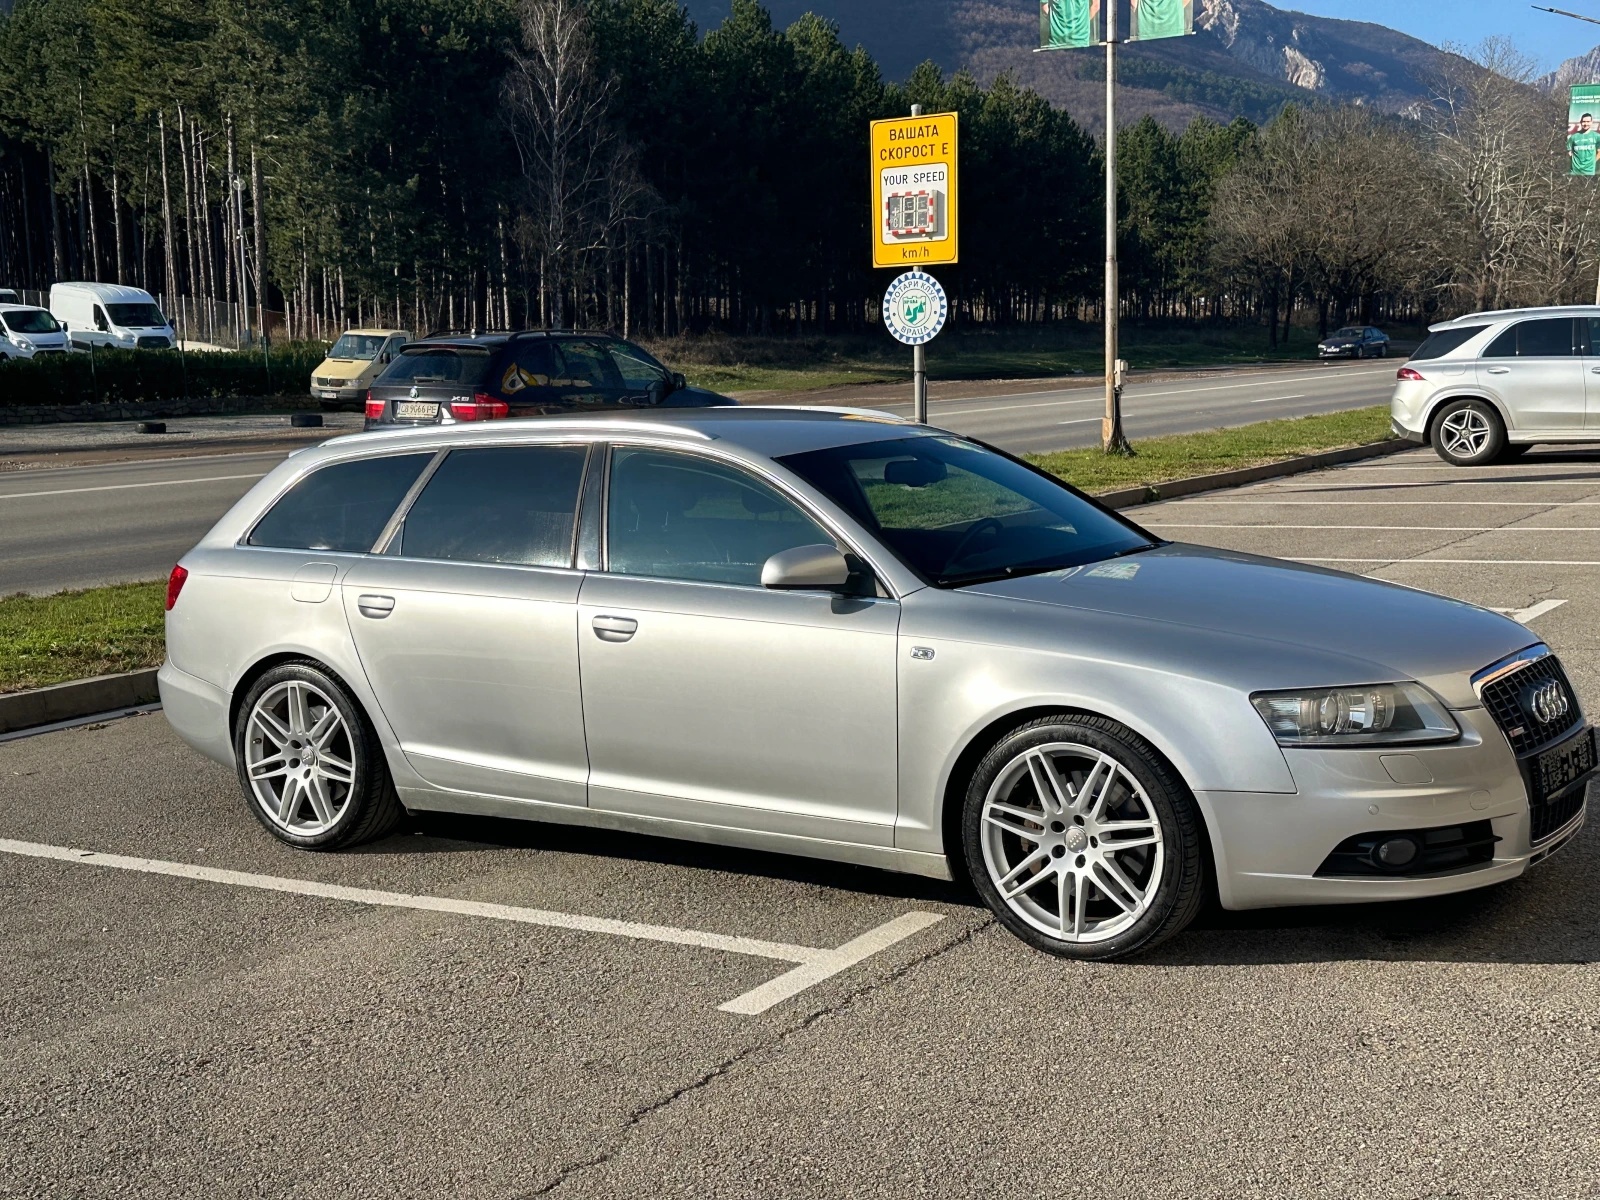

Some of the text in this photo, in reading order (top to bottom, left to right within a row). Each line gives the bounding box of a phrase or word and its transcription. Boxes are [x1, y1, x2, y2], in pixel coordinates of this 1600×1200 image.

[889, 124, 939, 141] ВАШАТА
[880, 142, 949, 161] СКОРОСТ Е
[883, 171, 945, 186] YOUR SPEED
[902, 246, 930, 259] km/h
[892, 280, 938, 304] РОТАРИ КЛУБ
[900, 325, 930, 336] ВРАЦА
